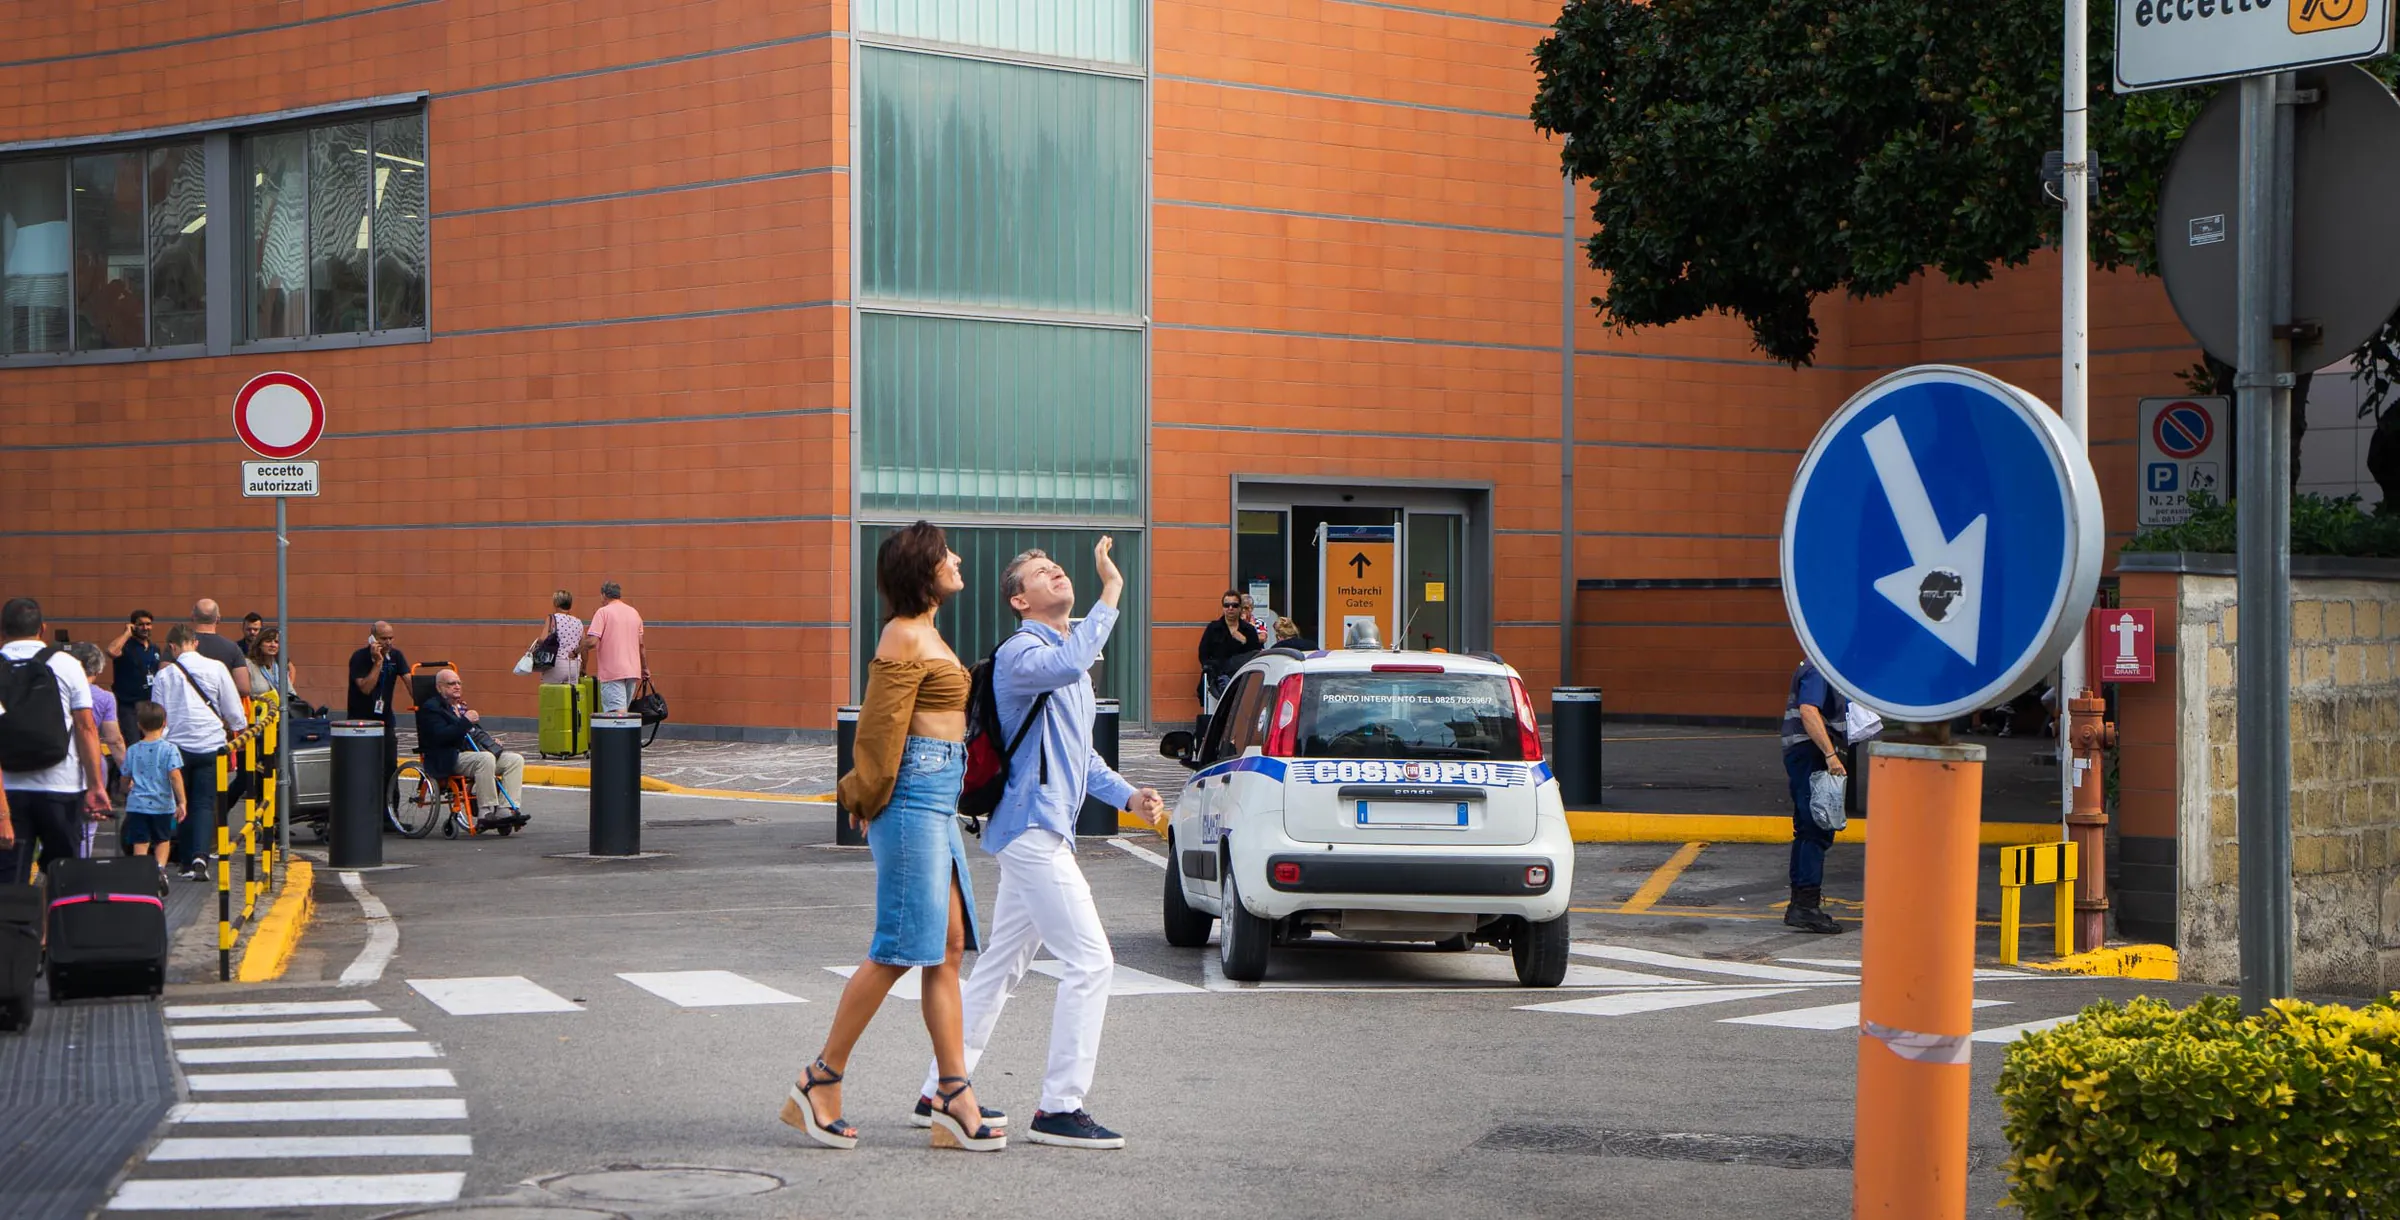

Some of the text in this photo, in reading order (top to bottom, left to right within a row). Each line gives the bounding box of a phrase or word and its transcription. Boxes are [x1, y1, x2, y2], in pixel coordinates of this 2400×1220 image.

[257, 465, 304, 476] eccetto
[2154, 467, 2172, 489] P
[249, 480, 312, 491] autorizzati
[2166, 495, 2174, 506] 2
[1337, 586, 1382, 595] Imbarchi
[1345, 598, 1374, 608] Gates
[1322, 694, 1359, 702] PRONTO
[1360, 695, 1416, 703] INTERVENTO
[1417, 696, 1434, 704] TEL
[1435, 696, 1455, 704] 0825
